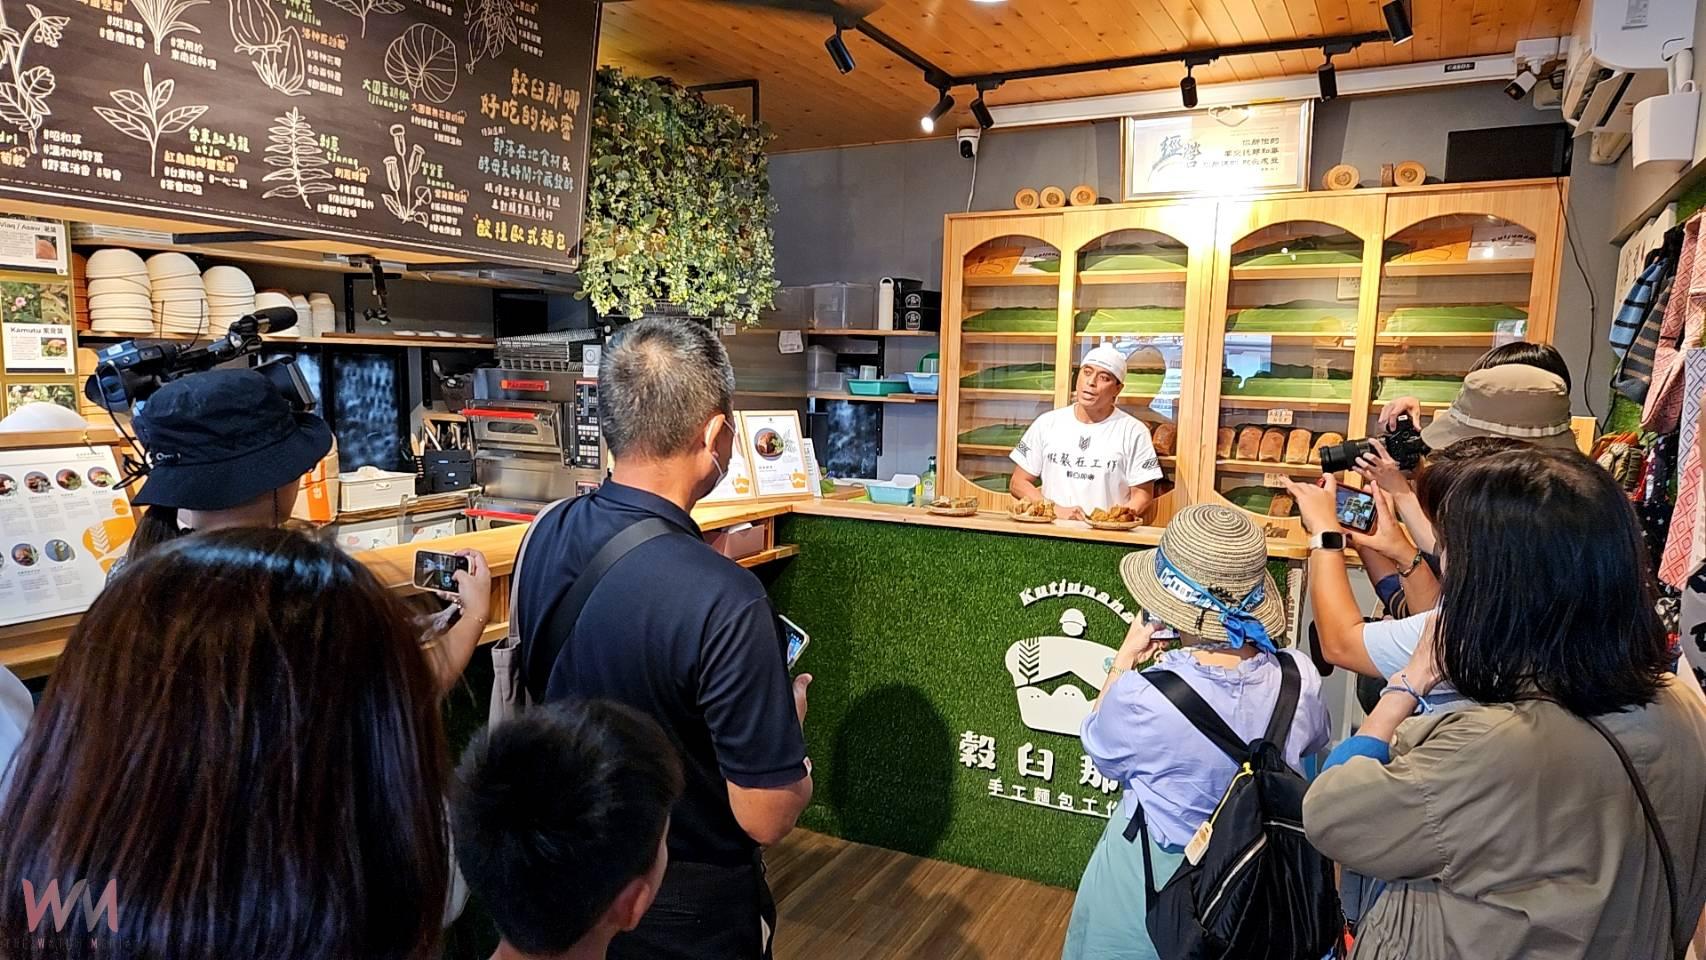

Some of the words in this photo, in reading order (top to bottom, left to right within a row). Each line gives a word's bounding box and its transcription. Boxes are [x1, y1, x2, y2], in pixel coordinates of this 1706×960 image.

[476, 218, 566, 250] 酸種歐式麵包
